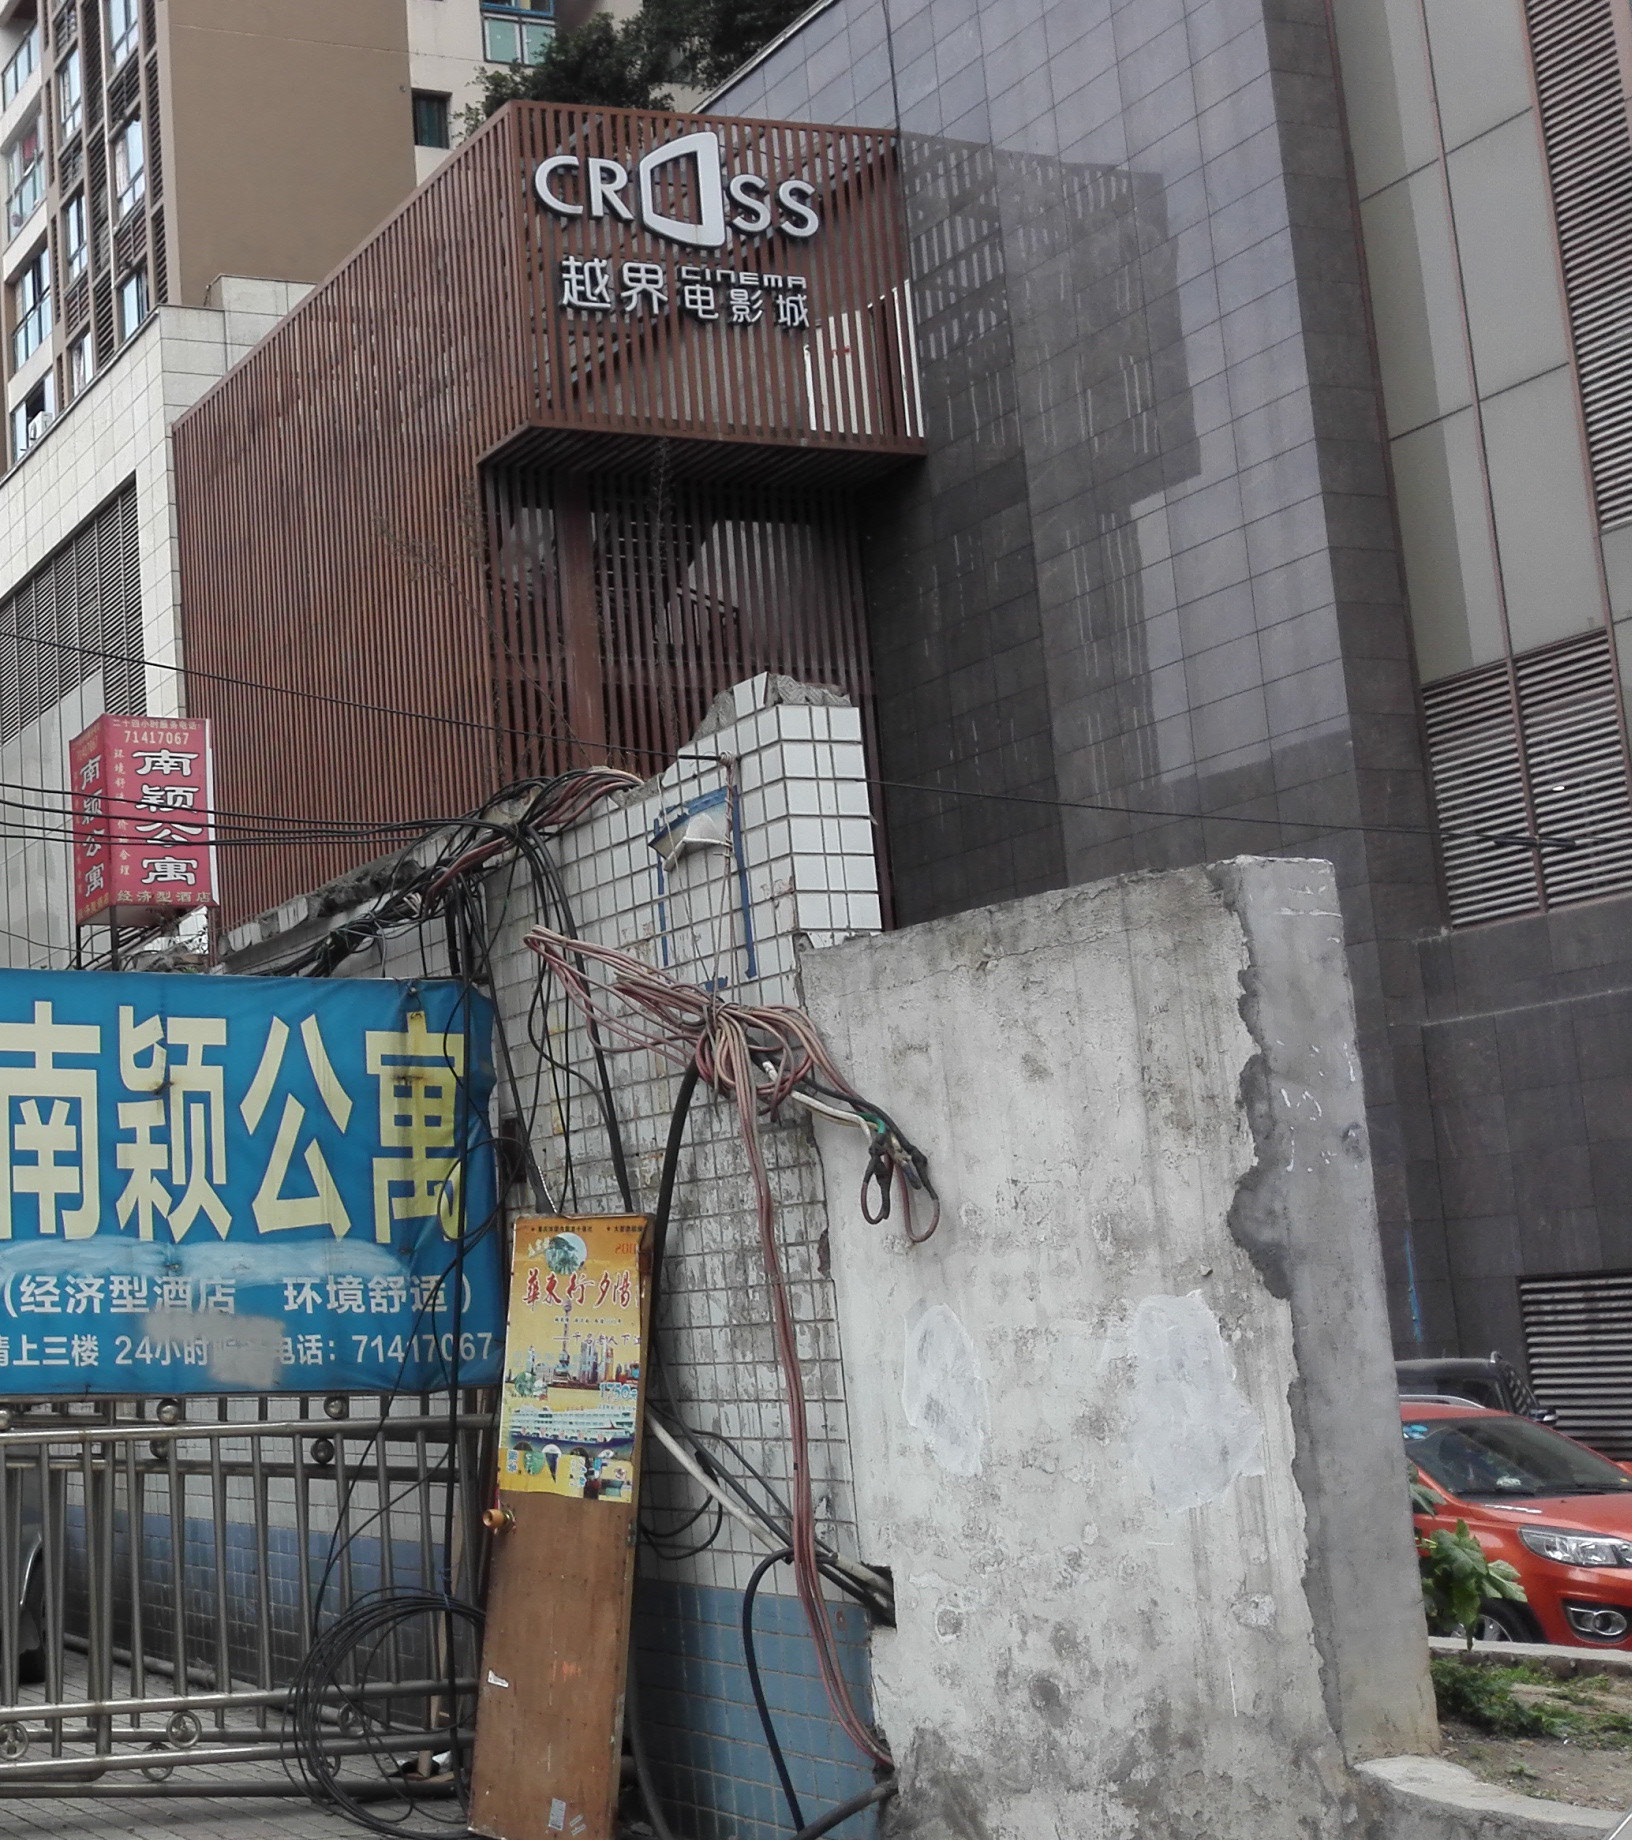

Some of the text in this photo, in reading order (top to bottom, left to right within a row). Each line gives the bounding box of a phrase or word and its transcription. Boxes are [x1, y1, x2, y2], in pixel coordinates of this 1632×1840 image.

[534, 131, 820, 247] CROSS
[124, 730, 190, 745] 71417067
[79, 754, 105, 898] 南颖公寓
[132, 749, 204, 886] 南颖公寓
[116, 889, 212, 904] 经济型酒店
